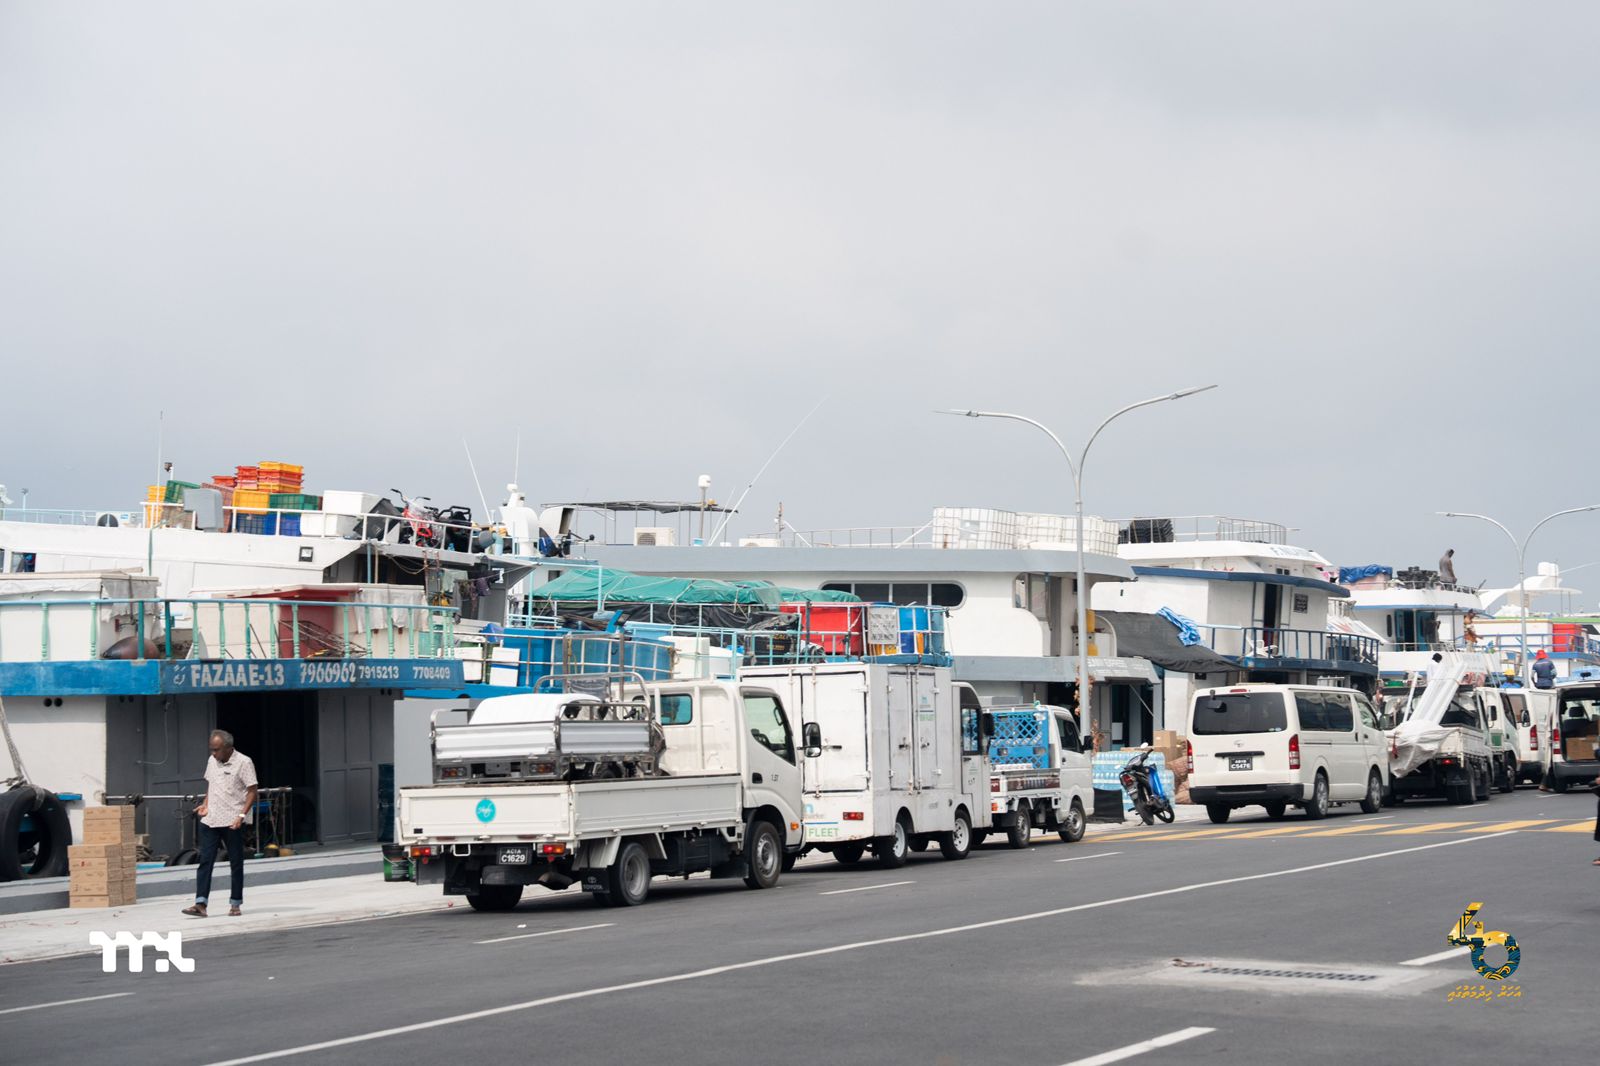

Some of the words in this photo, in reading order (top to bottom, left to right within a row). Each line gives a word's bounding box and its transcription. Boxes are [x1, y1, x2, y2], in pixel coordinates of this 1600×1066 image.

[299, 662, 357, 684] 7966962
[358, 665, 400, 679] 7915213
[412, 666, 451, 680] 7708409
[808, 827, 840, 838] FLEET
[501, 854, 526, 863] C1629
